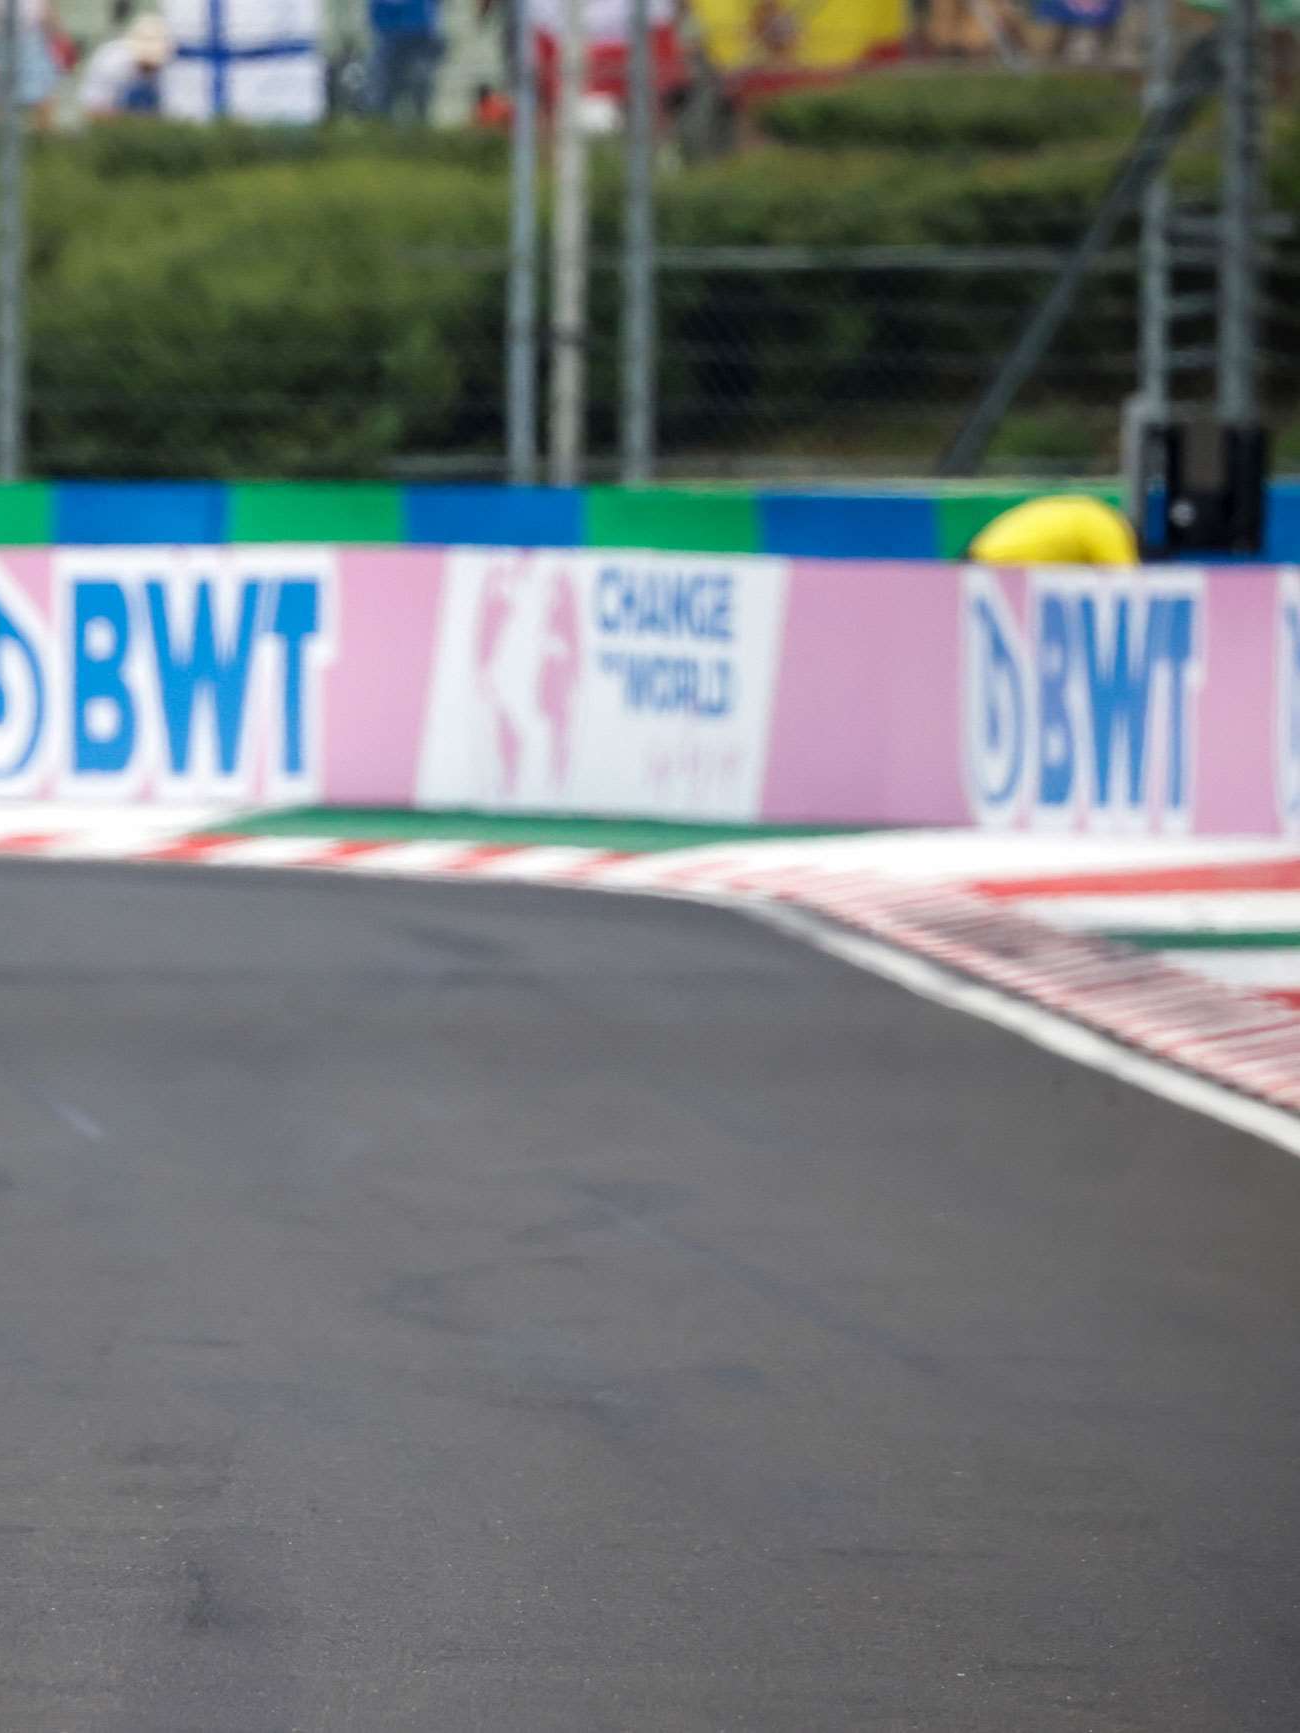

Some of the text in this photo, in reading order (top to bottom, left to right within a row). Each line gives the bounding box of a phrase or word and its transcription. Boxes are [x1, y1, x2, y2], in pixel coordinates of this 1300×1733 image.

[594, 567, 734, 641] CHANGE
[73, 579, 318, 775] BWT
[623, 654, 733, 717] WORLD
[1038, 594, 1197, 808] BWT
